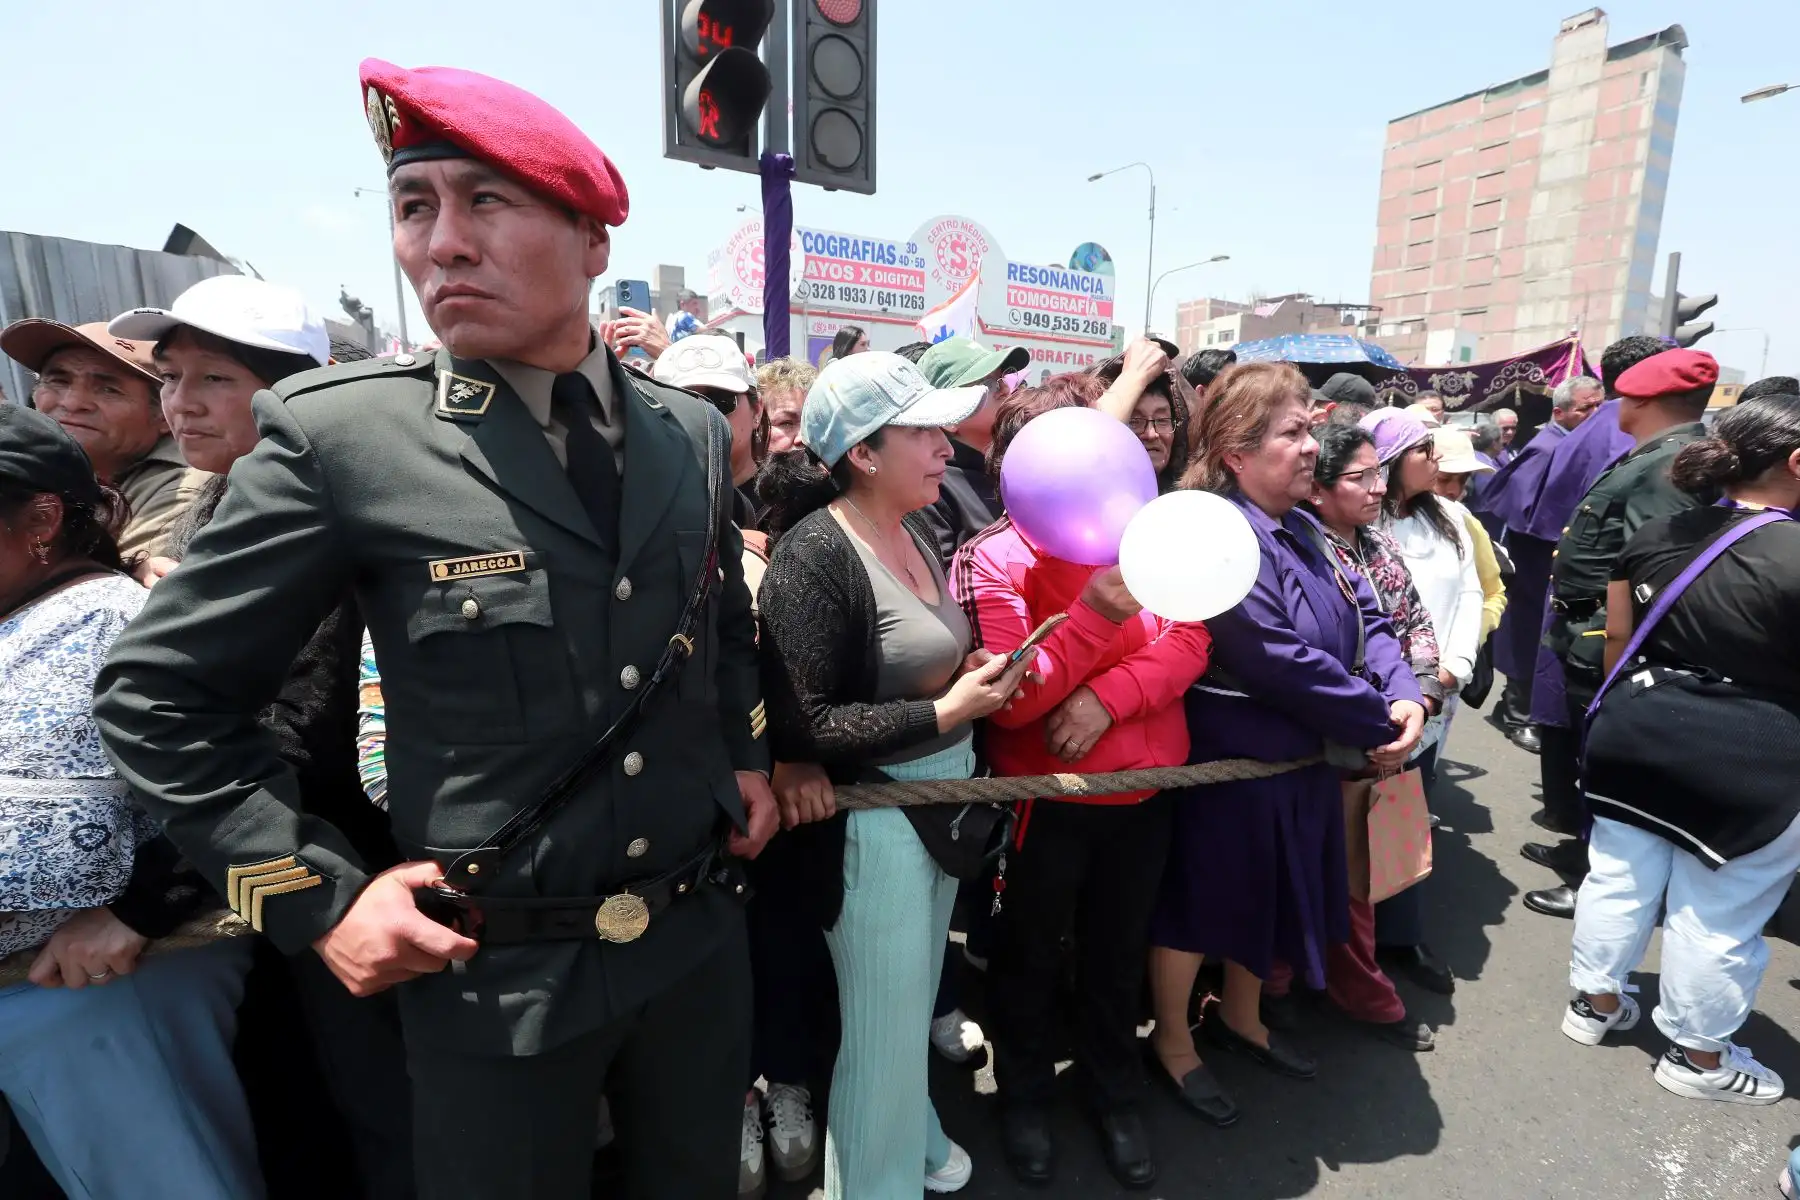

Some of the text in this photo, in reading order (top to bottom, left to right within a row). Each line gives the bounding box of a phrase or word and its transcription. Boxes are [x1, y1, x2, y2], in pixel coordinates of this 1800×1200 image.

[726, 221, 761, 255] CENTRO
[801, 230, 897, 266] COGRAFIAS
[906, 242, 918, 255] 3D
[927, 219, 989, 254] CENTRO MÉDICO
[805, 259, 855, 282] AYOS
[861, 267, 873, 284] X
[874, 271, 924, 290] DIGITAL
[1007, 262, 1105, 295] RESONANCIA
[812, 282, 836, 301] 328
[838, 285, 867, 304] 1933
[877, 290, 897, 308] 641
[898, 293, 925, 312] 1263
[1023, 311, 1108, 336] 949 535 268
[993, 343, 1095, 367] TOGRAFIAS
[453, 556, 516, 574] JARECCA
